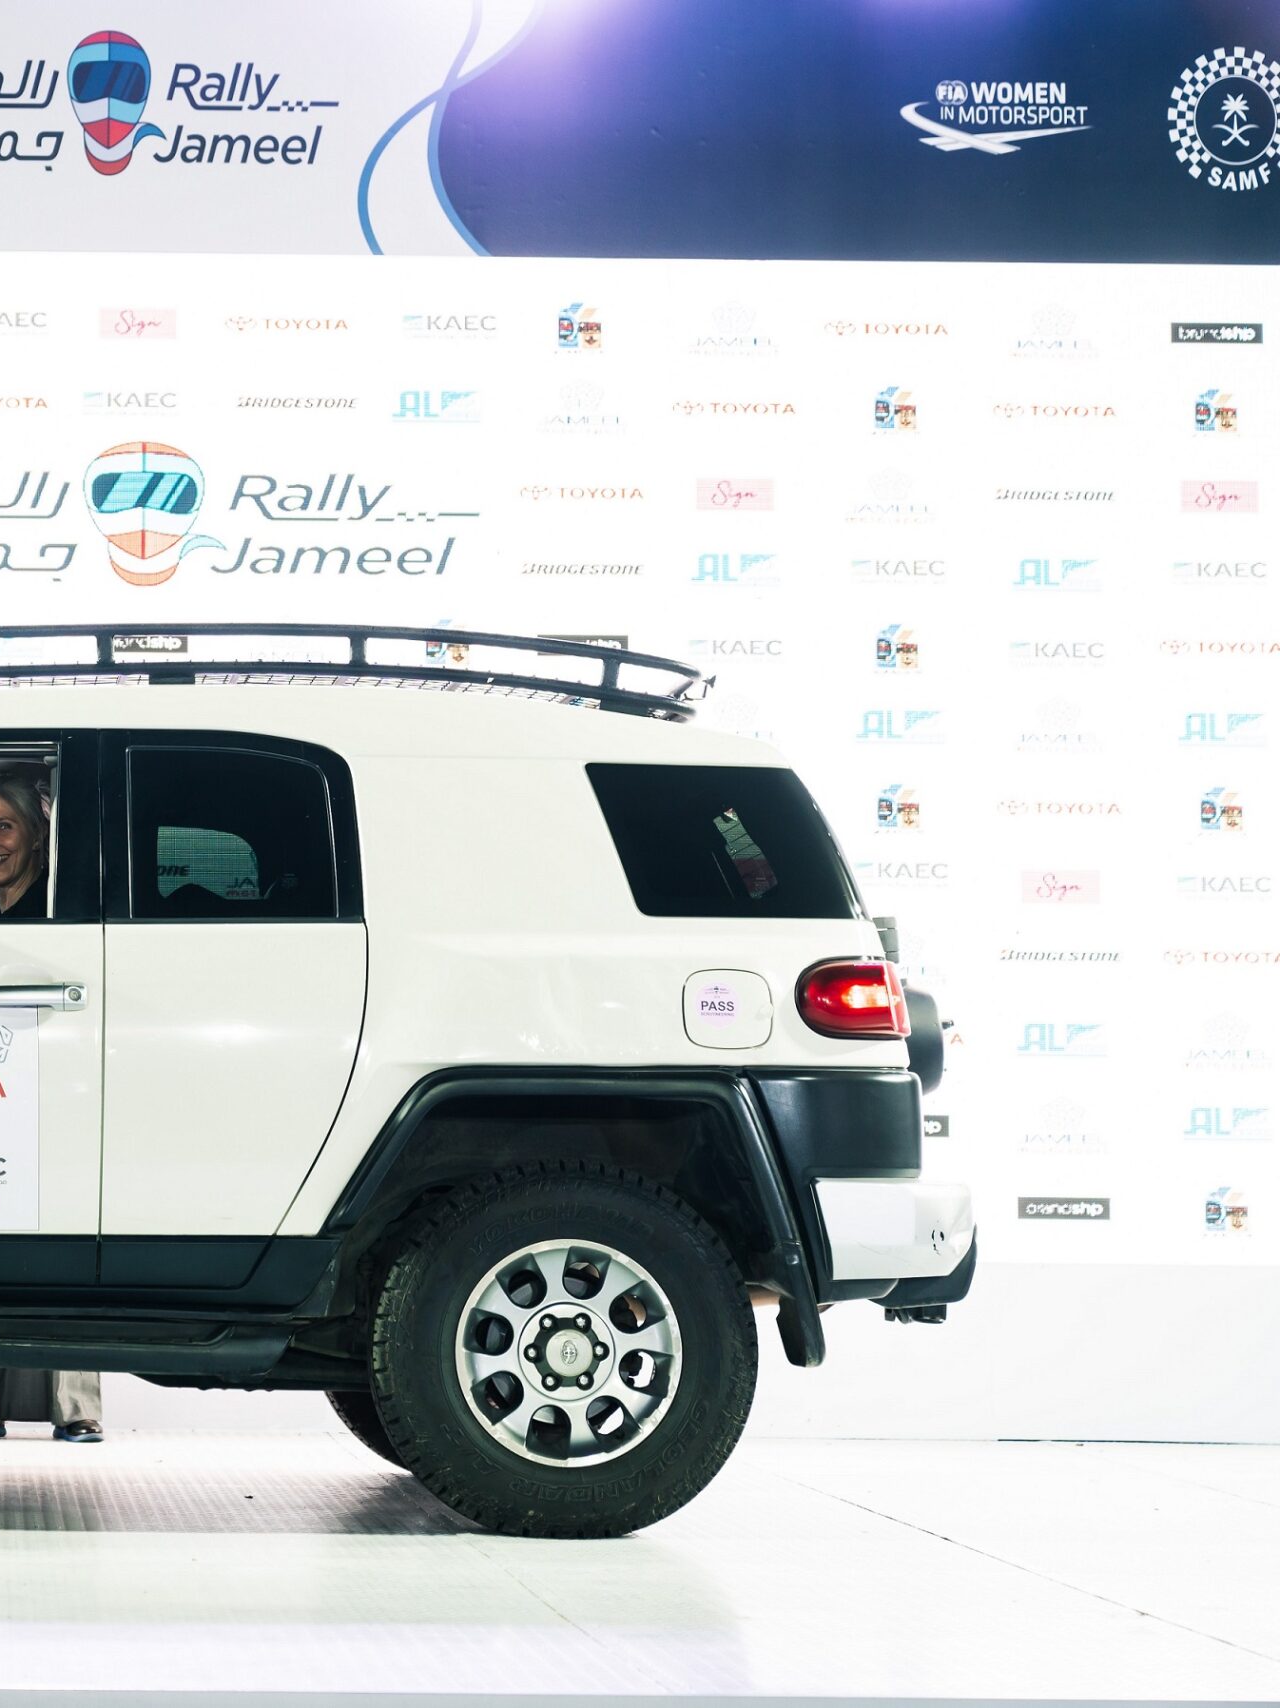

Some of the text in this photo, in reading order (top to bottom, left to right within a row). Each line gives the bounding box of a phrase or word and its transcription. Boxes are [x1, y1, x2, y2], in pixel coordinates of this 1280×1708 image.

[167, 63, 280, 111] Rally
[971, 82, 1066, 104] WOMEN
[940, 106, 1088, 125] IN MOTORSPORT
[153, 125, 322, 165] Jameel
[1208, 162, 1272, 191] SAMF
[264, 318, 348, 331] TOYOTA
[427, 314, 496, 331] KAEC
[863, 323, 949, 335] TOYOTA
[107, 393, 177, 408] KAEC
[710, 402, 795, 415] TOYOTA
[1031, 405, 1116, 418] TOYOTA
[229, 474, 393, 521] Rally
[560, 487, 643, 499] TOYOTA
[211, 536, 455, 576] Jameel
[876, 560, 945, 576] KAEC
[1197, 562, 1267, 578] KAEC
[712, 639, 782, 656] KAEC
[1034, 642, 1104, 659] KAEC
[1035, 801, 1122, 815] TOYOTA
[878, 862, 948, 879] KAEC
[1201, 876, 1271, 893] KAEC
[701, 1001, 735, 1012] PASS
